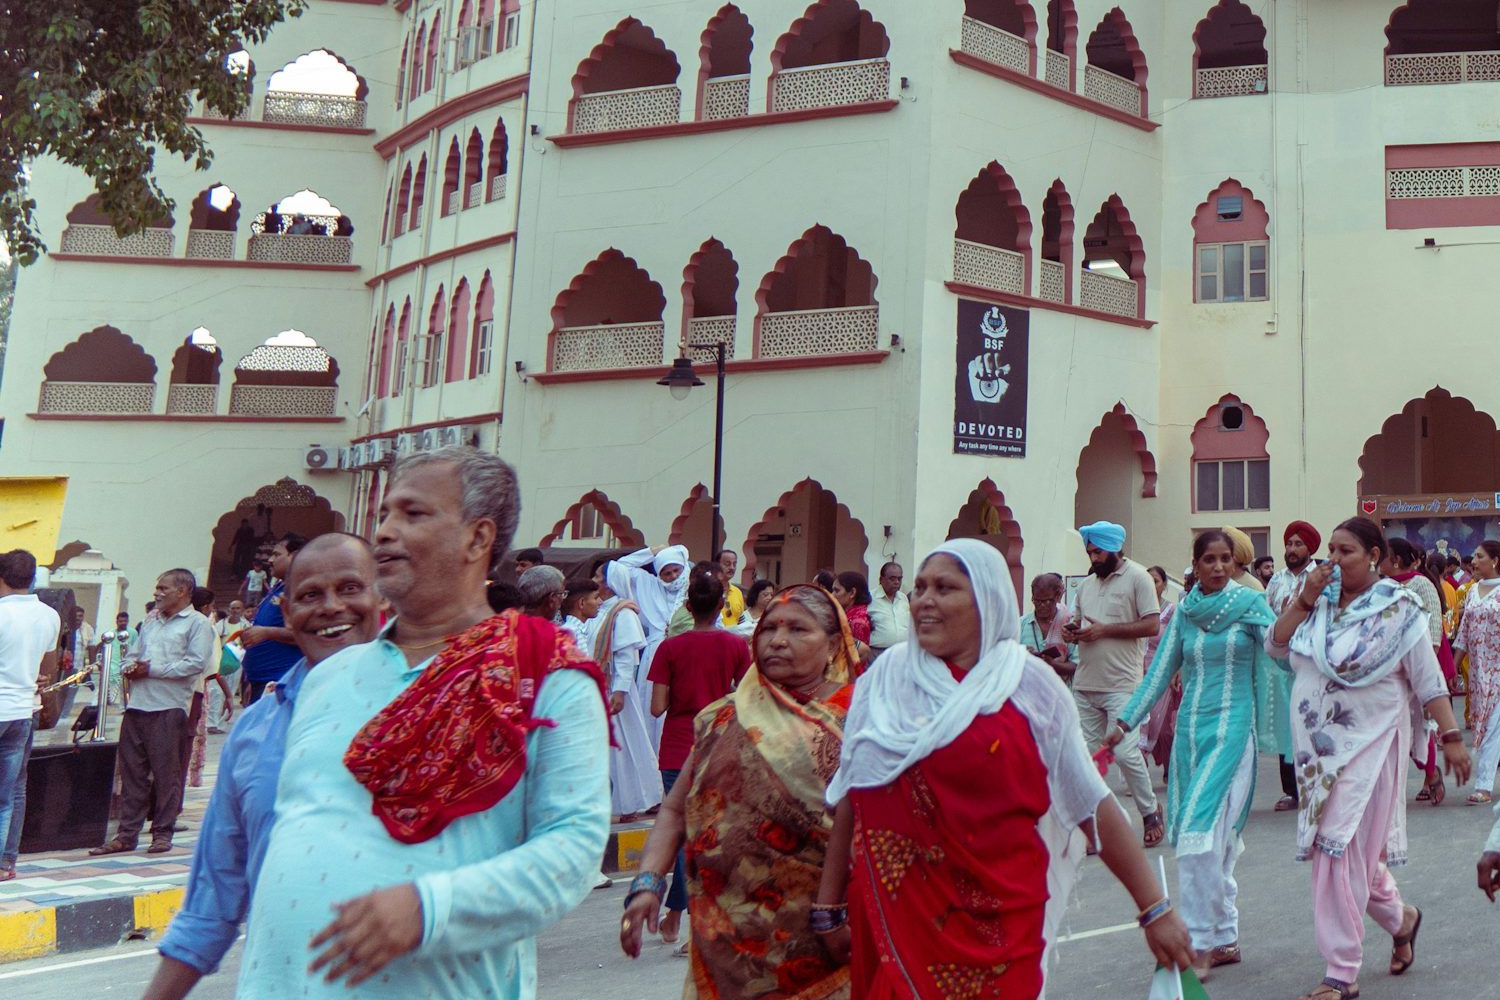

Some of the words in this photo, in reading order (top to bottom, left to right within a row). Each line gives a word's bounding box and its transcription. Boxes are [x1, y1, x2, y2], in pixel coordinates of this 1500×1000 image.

[984, 338, 1004, 351] BSF
[958, 421, 1023, 439] DEVOTED
[958, 441, 968, 450] Any
[1008, 445, 1022, 453] where
[1386, 499, 1425, 513] Welcome
